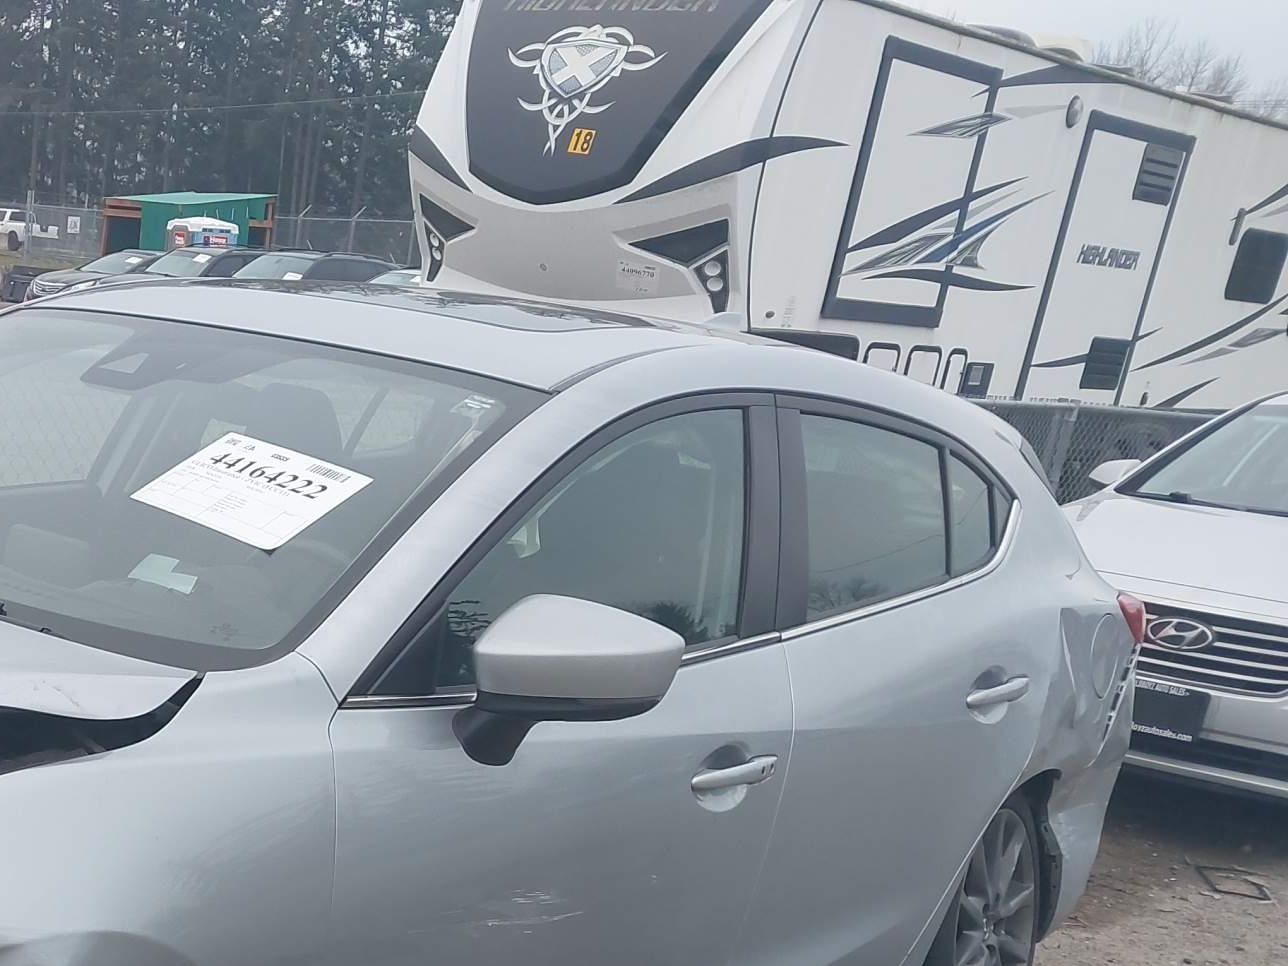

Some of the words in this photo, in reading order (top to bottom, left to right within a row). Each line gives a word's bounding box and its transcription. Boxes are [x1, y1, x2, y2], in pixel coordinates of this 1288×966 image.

[574, 130, 594, 153] 18
[1076, 243, 1141, 270] HIGHLANDER
[210, 452, 329, 500] 44164222
